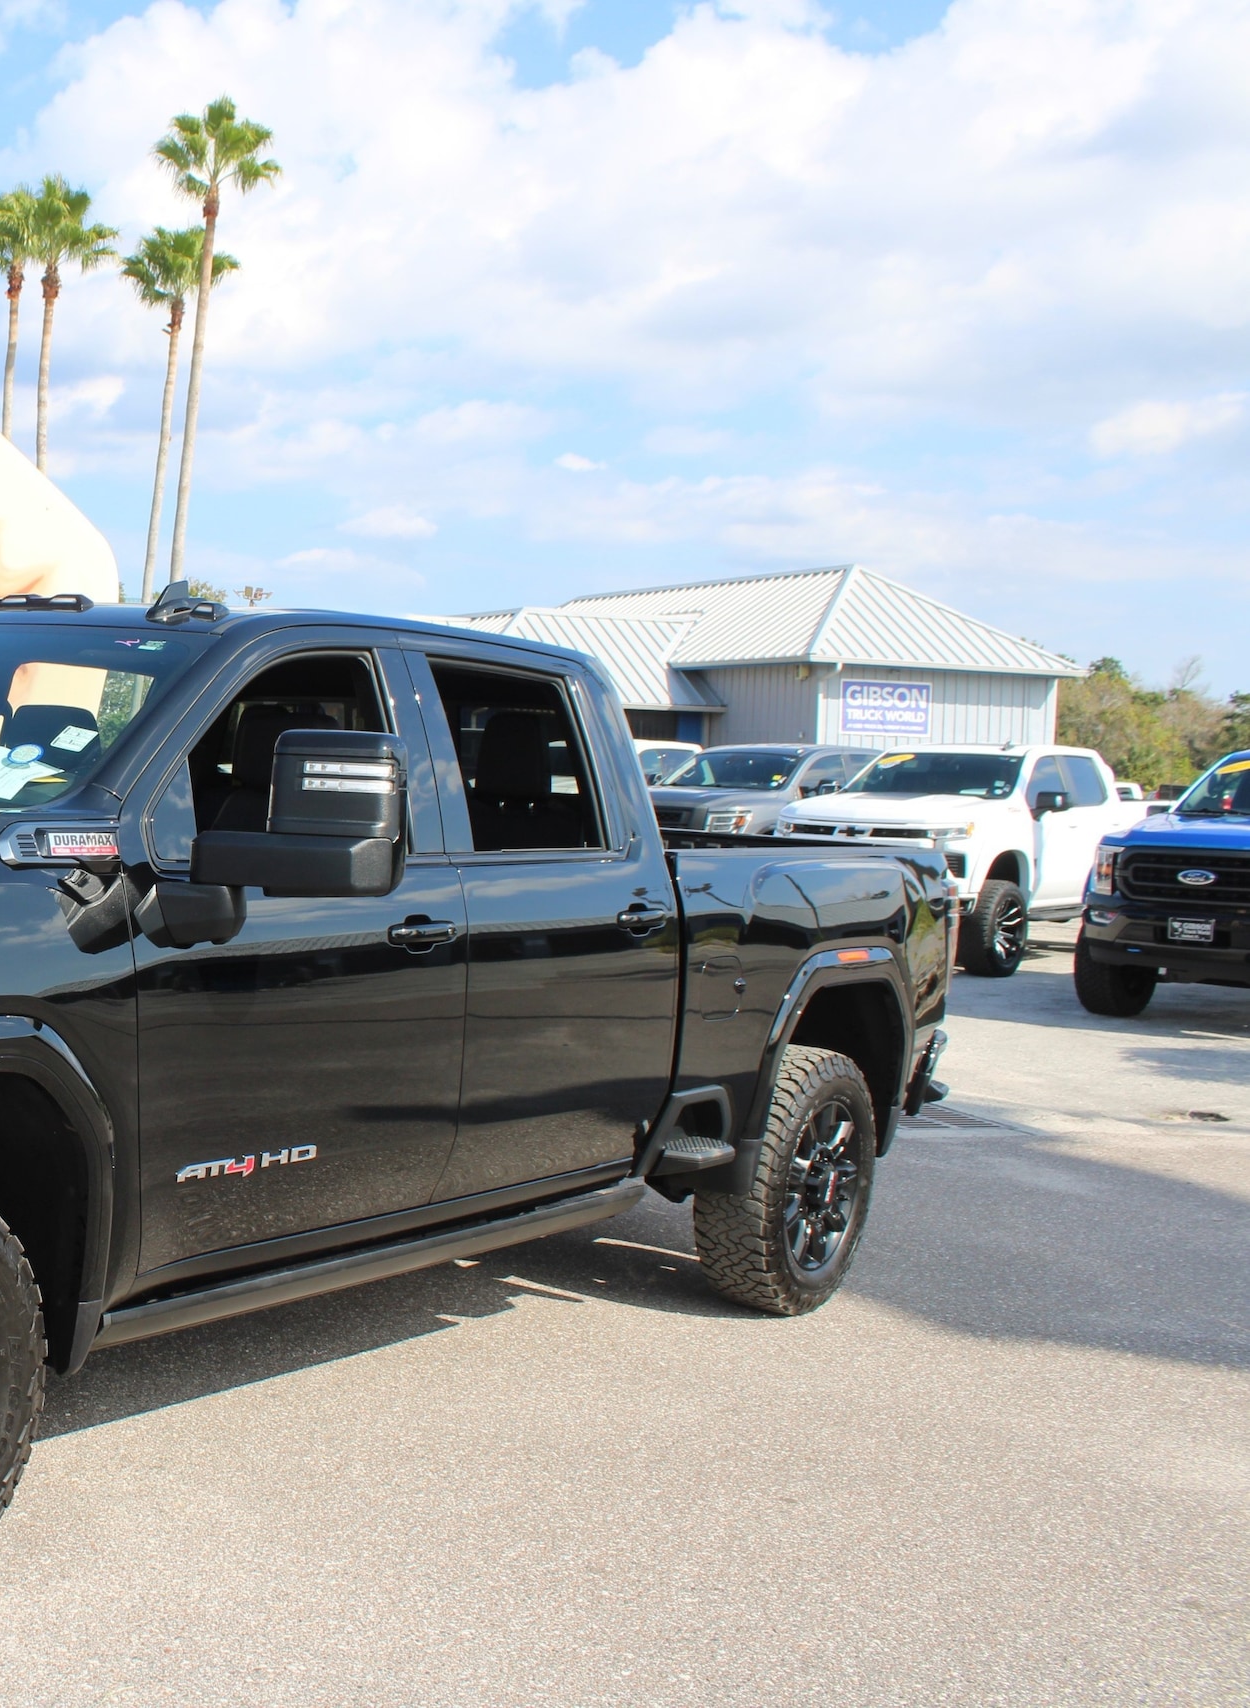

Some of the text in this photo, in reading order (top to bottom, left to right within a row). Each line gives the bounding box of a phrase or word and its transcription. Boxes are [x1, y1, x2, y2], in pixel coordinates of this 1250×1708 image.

[845, 685, 927, 709] GIBSON
[846, 708, 926, 723] TRUCK WORLD
[53, 834, 113, 846] DURAMAX
[175, 1143, 318, 1183] AT4 HD
